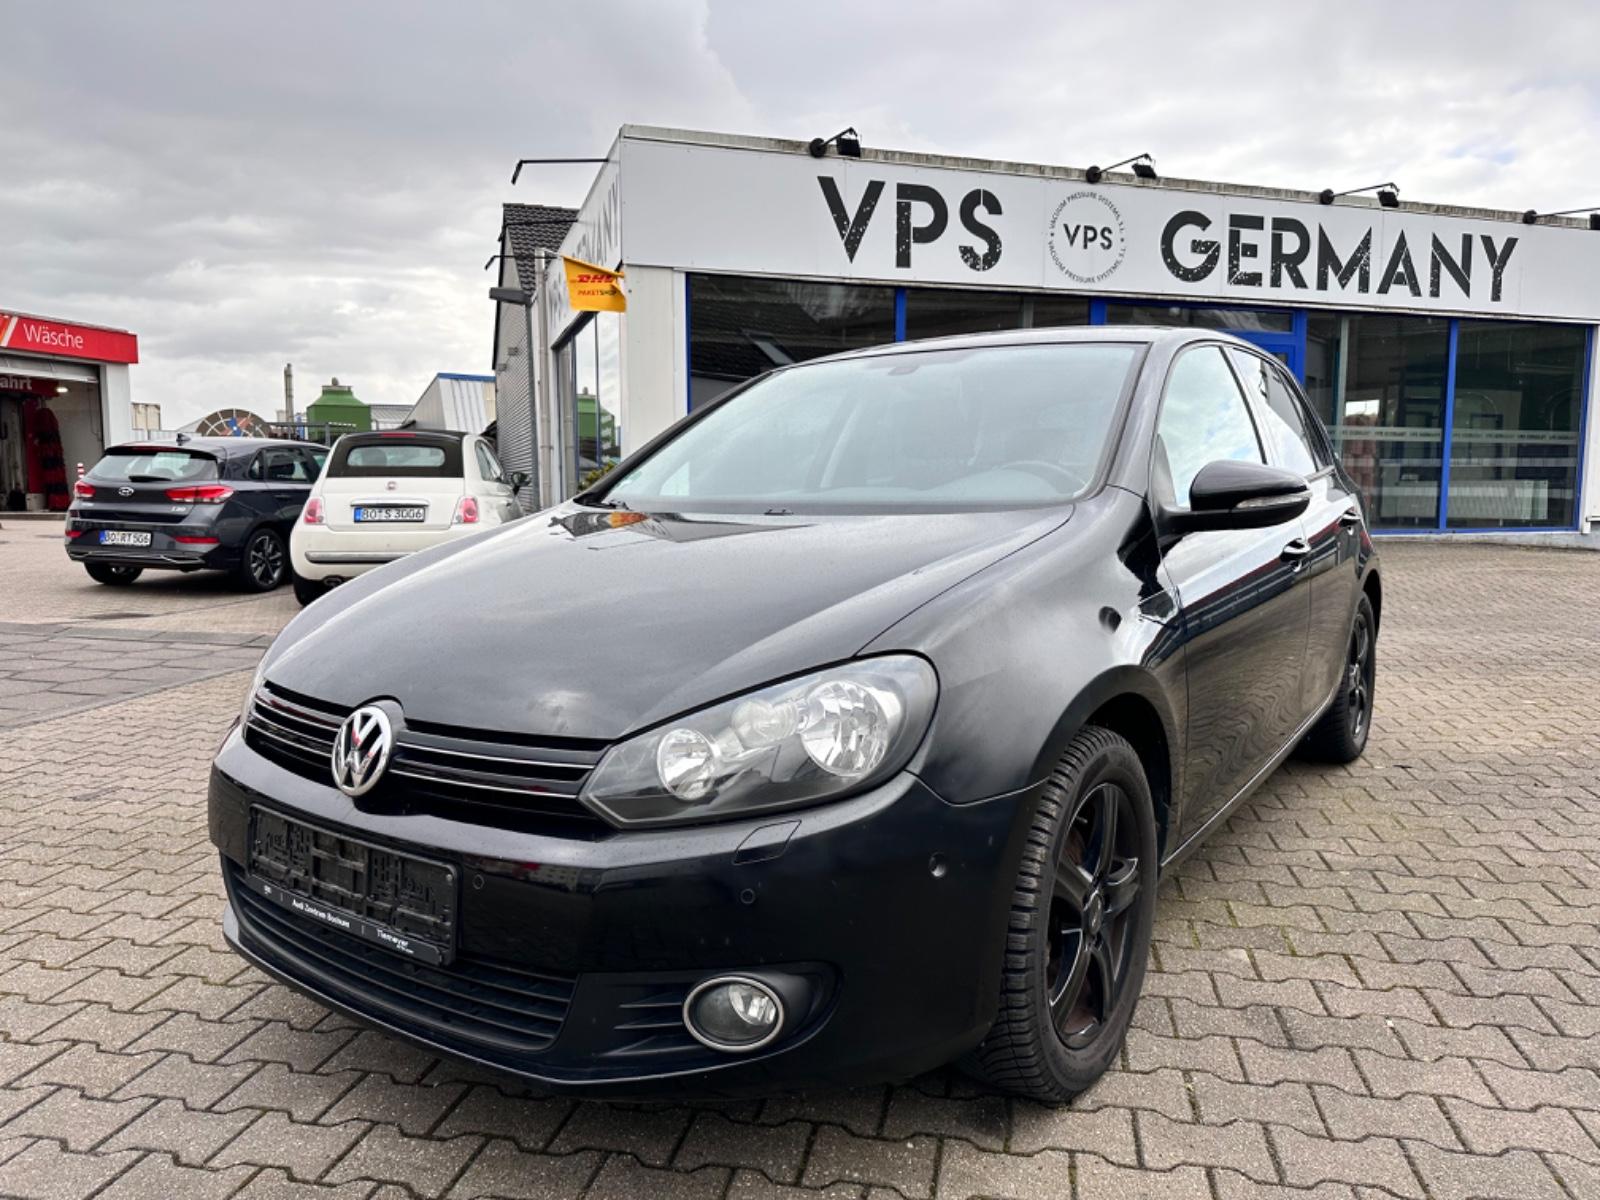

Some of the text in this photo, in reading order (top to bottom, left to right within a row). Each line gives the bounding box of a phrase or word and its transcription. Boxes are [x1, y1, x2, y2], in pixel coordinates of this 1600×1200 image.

[817, 176, 1519, 301] VPS GERMANY
[1063, 223, 1113, 250] VPS
[577, 274, 613, 283] DHL
[23, 323, 84, 349] Wäsche
